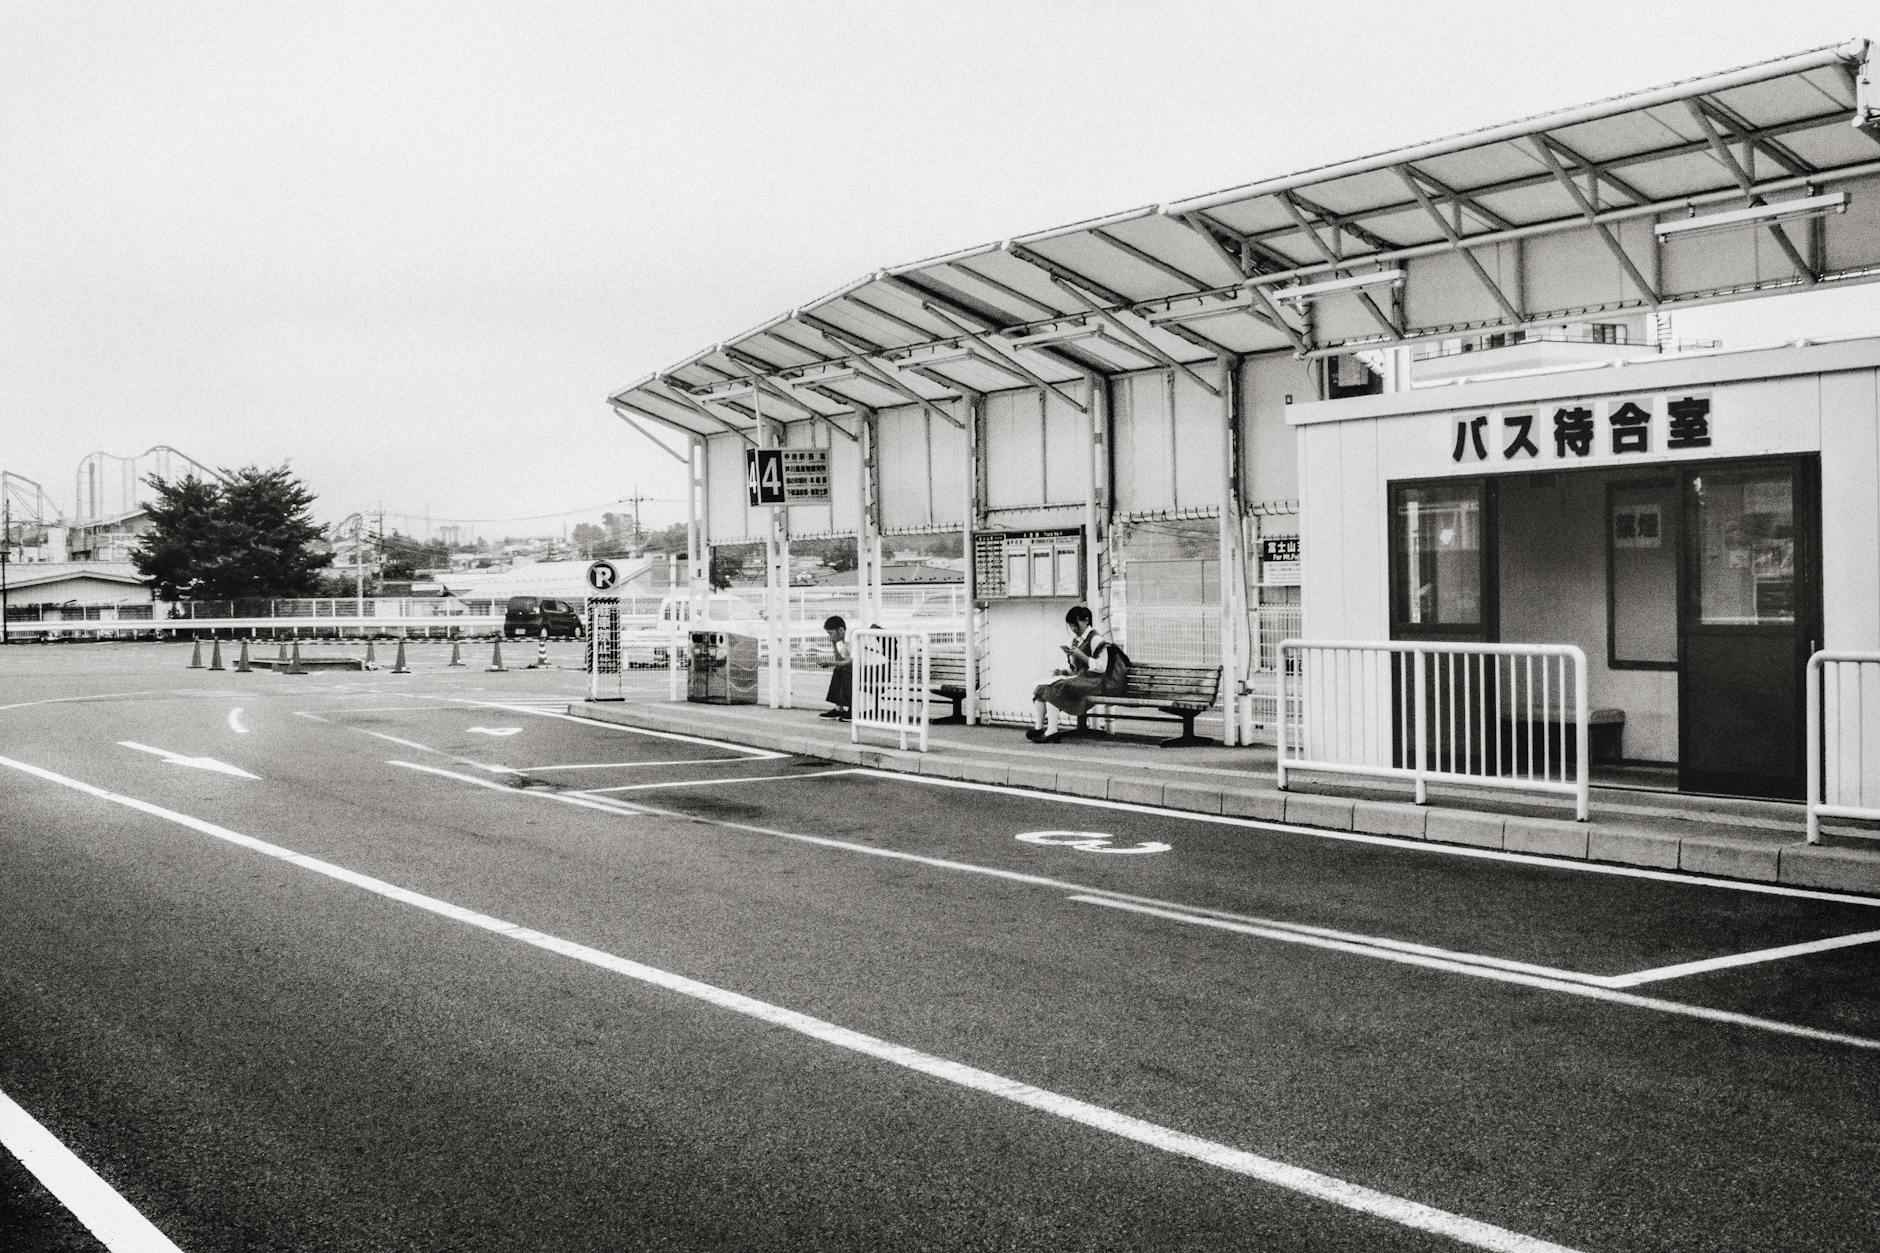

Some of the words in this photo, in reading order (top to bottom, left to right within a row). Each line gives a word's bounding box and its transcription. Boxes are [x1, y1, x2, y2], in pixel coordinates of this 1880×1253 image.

[1452, 397, 1712, 462] バス待合室
[748, 461, 758, 494] 4
[761, 457, 782, 496] 4
